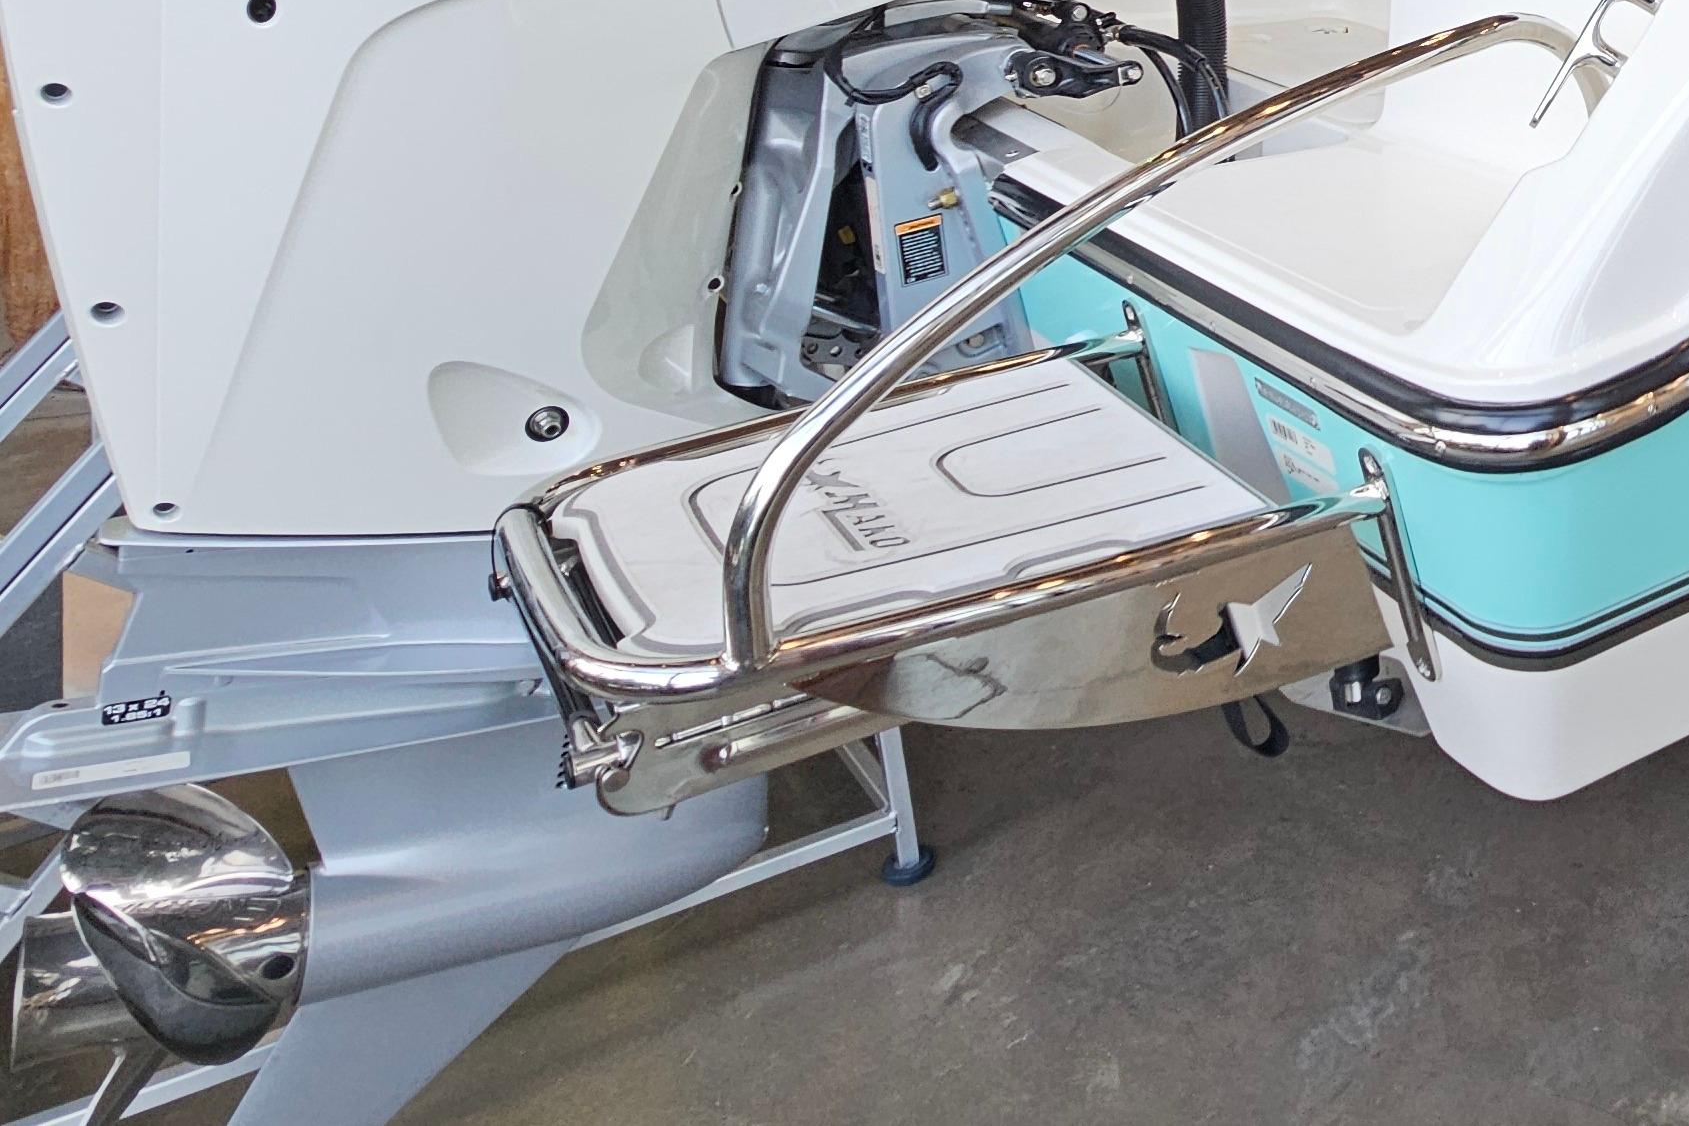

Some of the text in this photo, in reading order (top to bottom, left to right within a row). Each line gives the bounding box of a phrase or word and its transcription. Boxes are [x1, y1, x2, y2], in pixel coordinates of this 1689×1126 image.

[822, 492, 911, 552] MAKO
[103, 704, 126, 715] 13
[143, 697, 170, 710] 24
